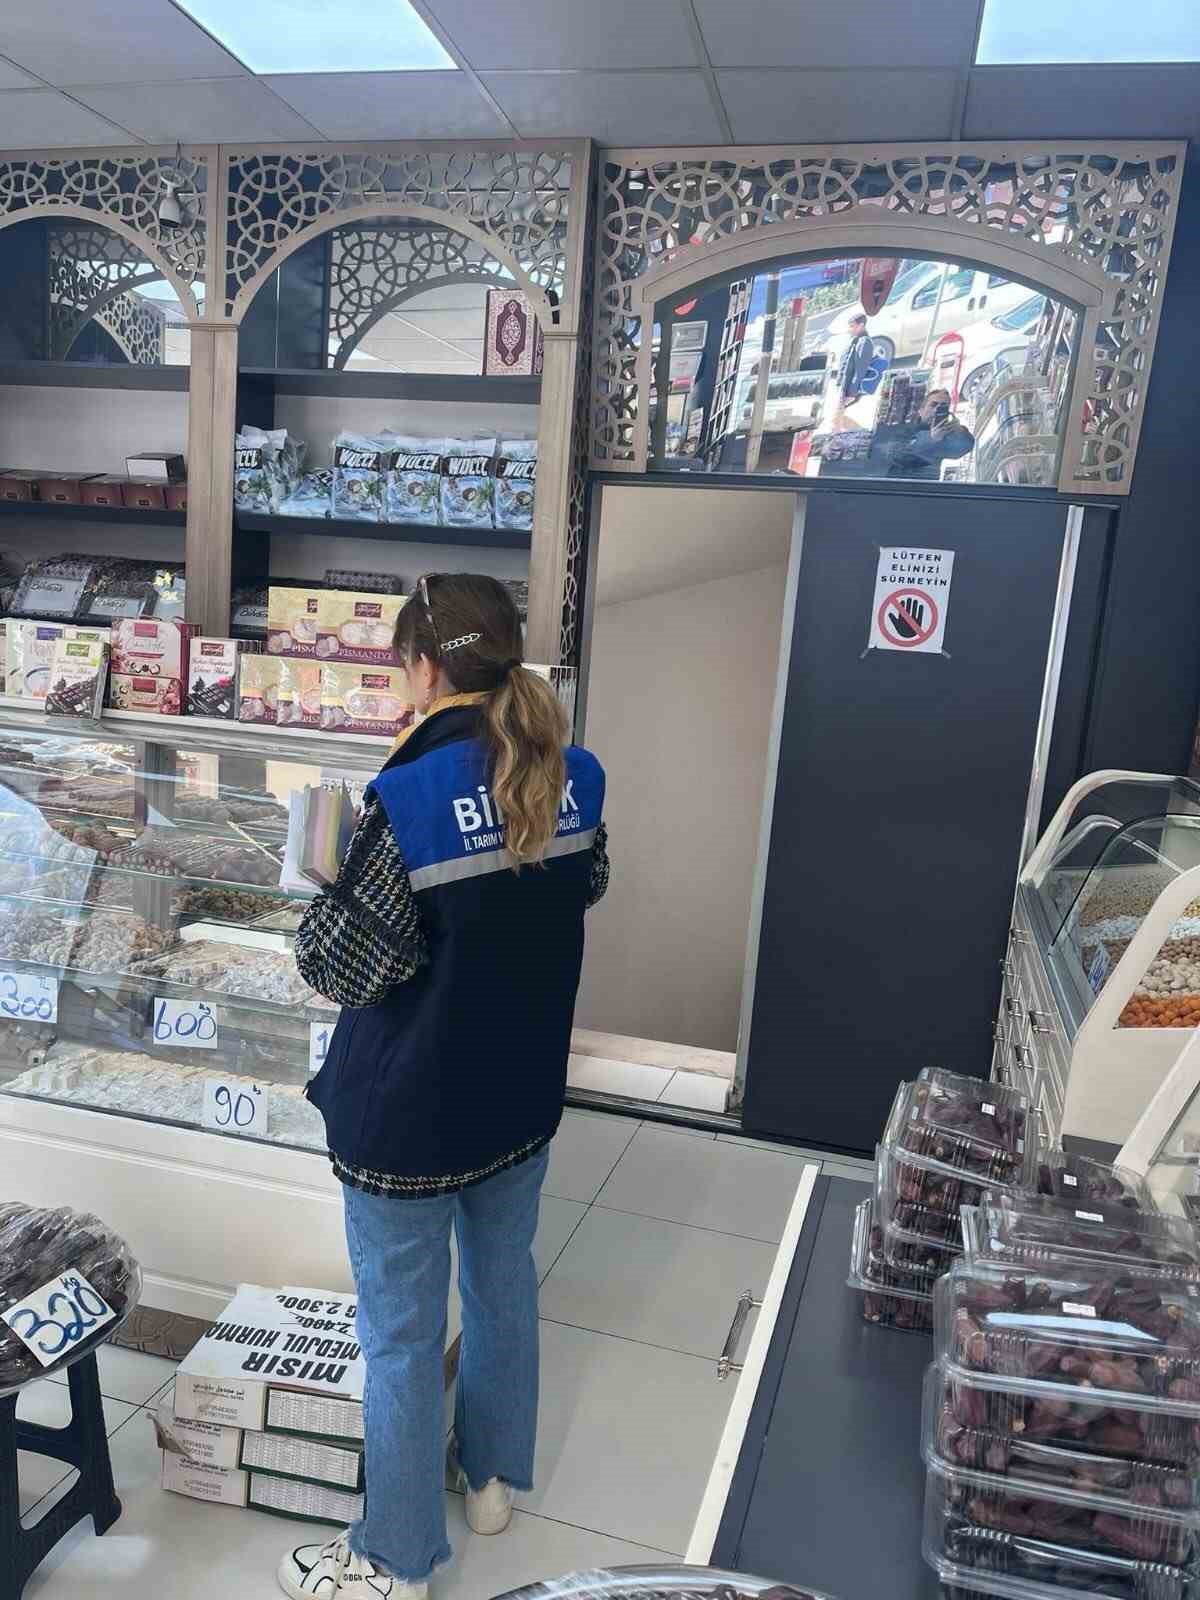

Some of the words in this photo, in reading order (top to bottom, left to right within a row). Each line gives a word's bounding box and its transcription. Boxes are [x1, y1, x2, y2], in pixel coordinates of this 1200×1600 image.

[892, 550, 942, 562] LÜTFEN
[471, 832, 498, 849] TARIM
[559, 813, 580, 832] RLÜĞÜ
[154, 1000, 217, 1041] 600
[215, 1086, 255, 1126] 90
[9, 1287, 108, 1354] 320
[205, 1321, 281, 1348] HURMA
[282, 1333, 361, 1361] MEDJUL
[241, 1351, 348, 1384] MISIR
